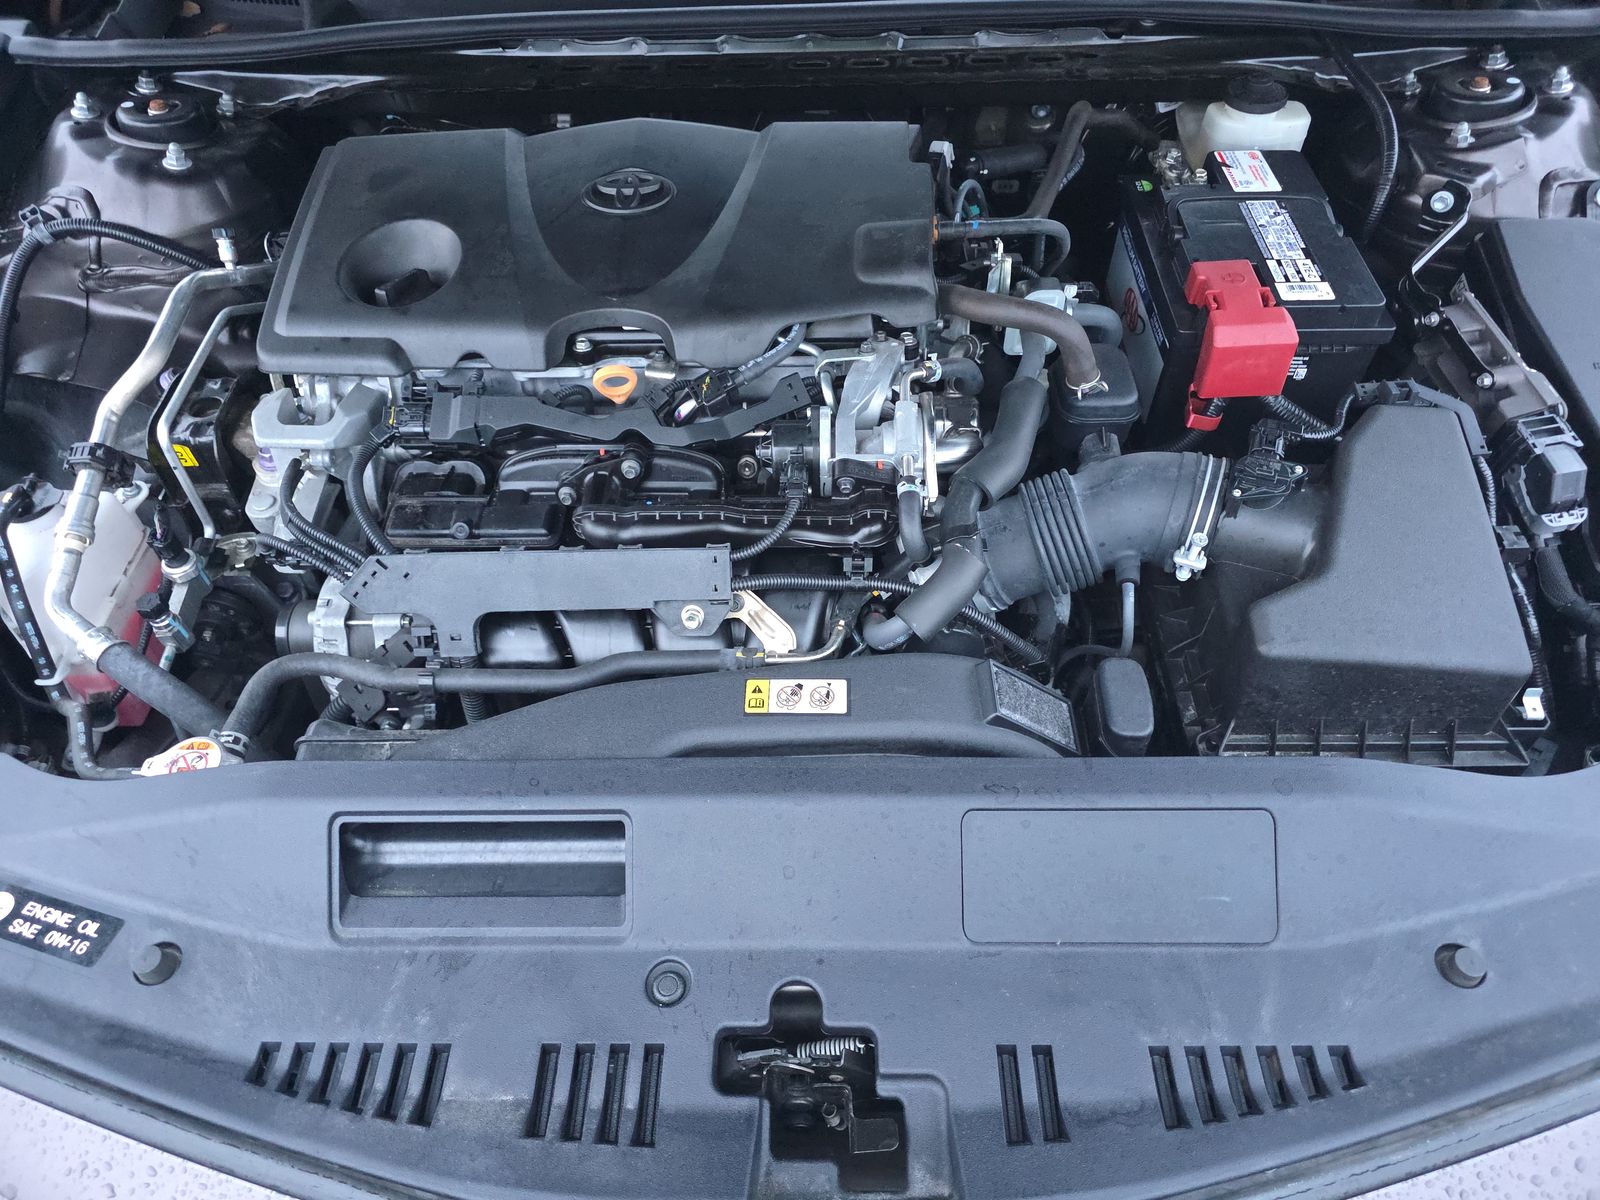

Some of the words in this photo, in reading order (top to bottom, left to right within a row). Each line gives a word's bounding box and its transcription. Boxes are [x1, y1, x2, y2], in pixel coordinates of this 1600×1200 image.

[8, 918, 42, 939] SAE
[43, 930, 90, 955] 0W-16
[21, 901, 76, 928] ENGINE
[77, 920, 101, 938] OIL
